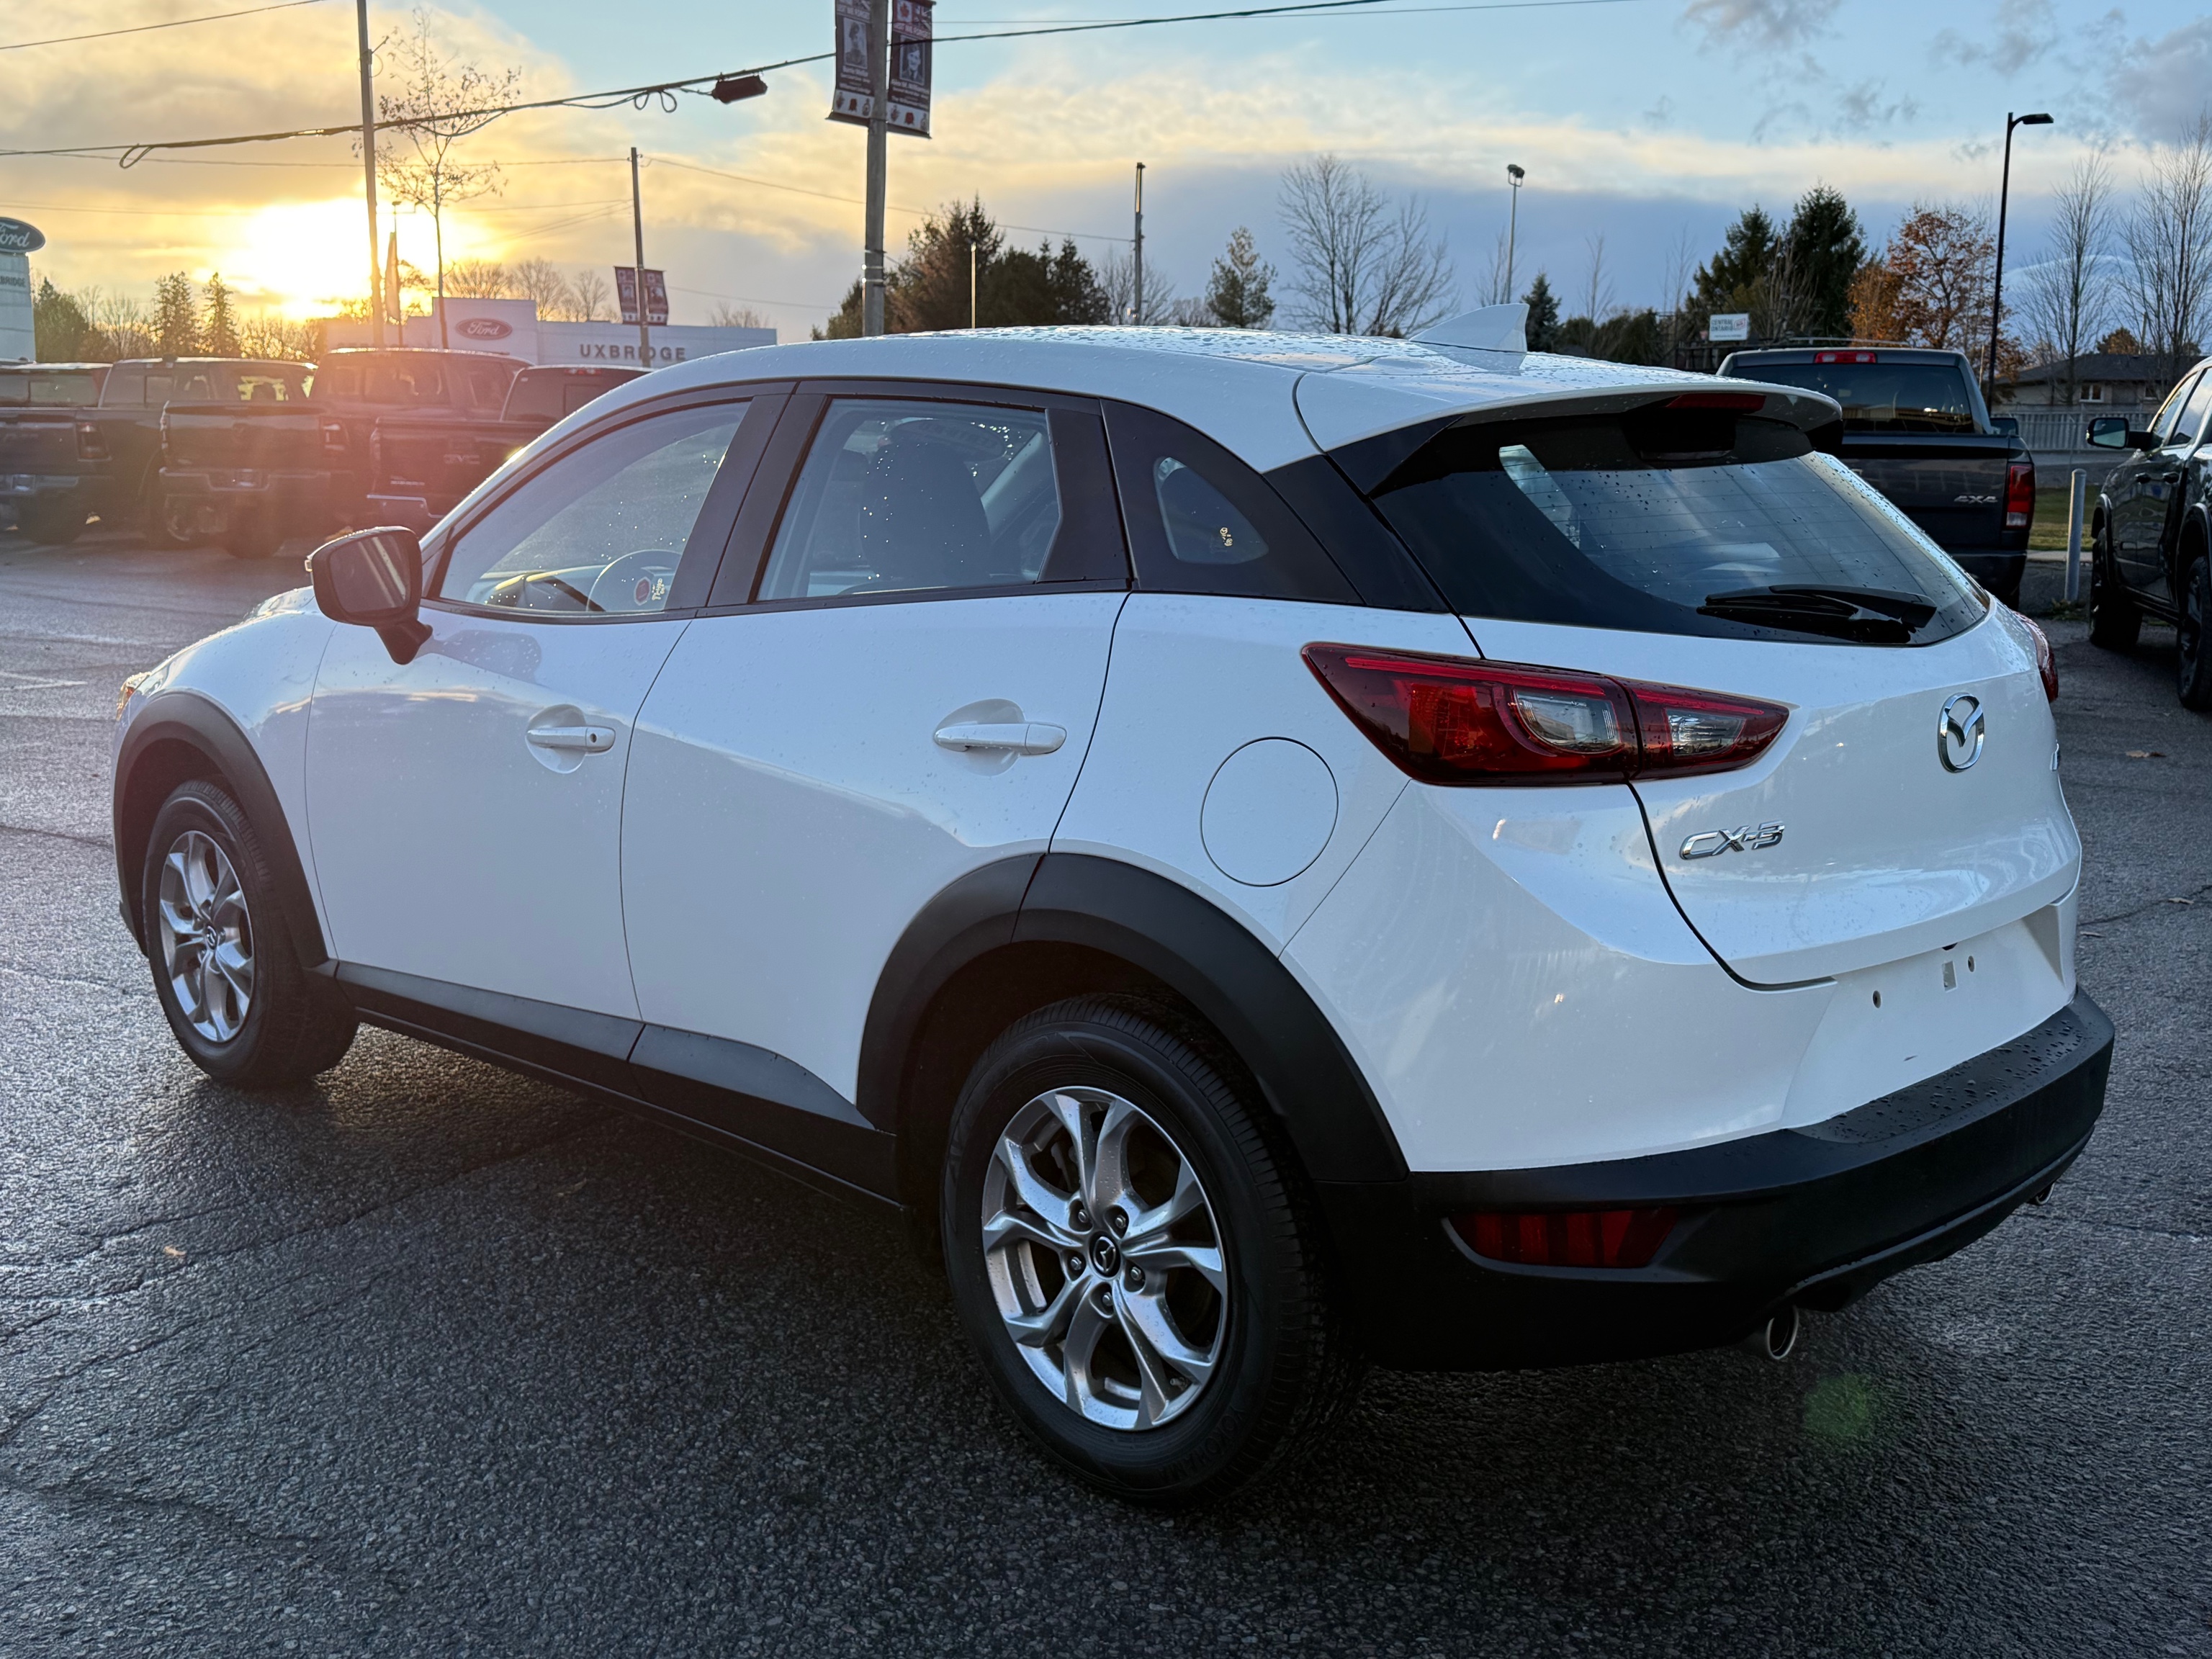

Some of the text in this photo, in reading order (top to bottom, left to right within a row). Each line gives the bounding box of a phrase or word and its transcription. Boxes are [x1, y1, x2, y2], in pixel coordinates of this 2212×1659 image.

[467, 321, 500, 336] Ford
[579, 343, 686, 361] UXBRIDGE
[1679, 821, 1785, 860] CX-3
